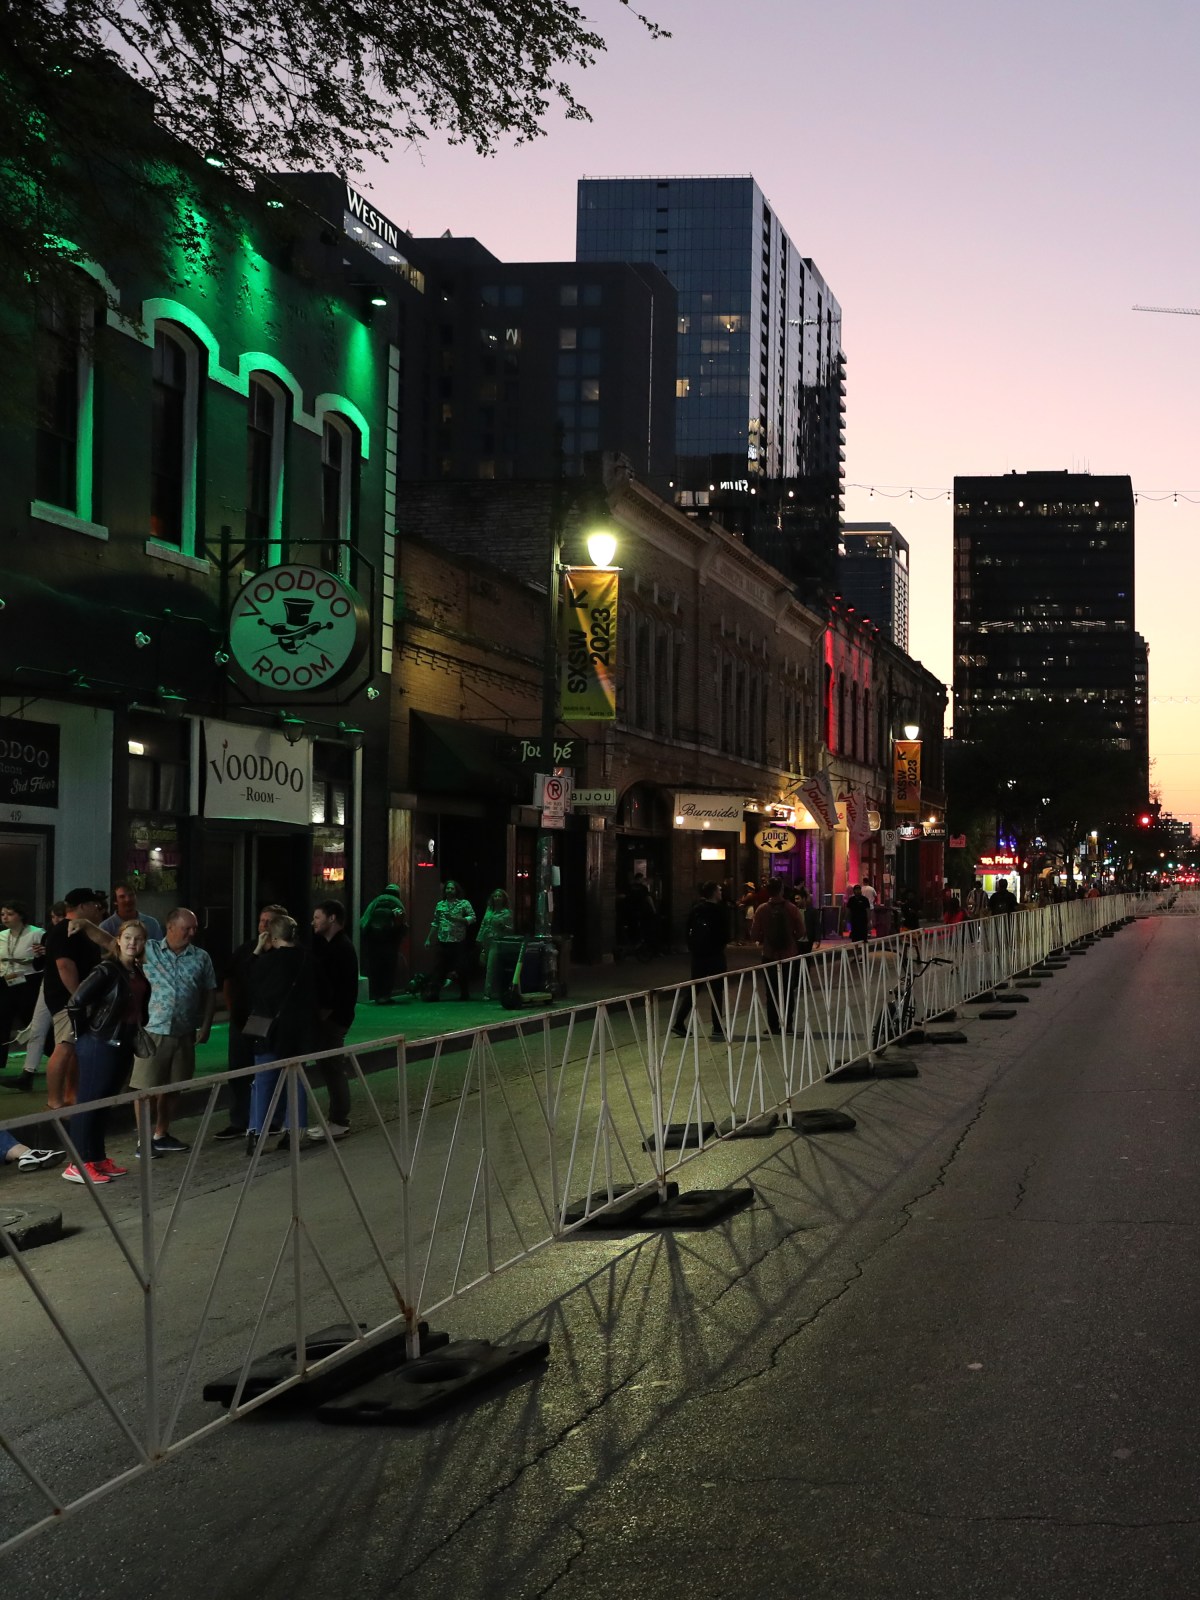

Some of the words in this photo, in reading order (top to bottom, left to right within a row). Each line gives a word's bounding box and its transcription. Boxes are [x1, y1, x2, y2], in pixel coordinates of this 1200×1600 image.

[346, 186, 398, 249] WESTIN
[239, 569, 351, 618] VOODOO
[589, 607, 611, 666] 2023
[252, 653, 334, 686] ROOM
[567, 629, 587, 694] SXSW
[209, 740, 304, 793] VOODOO
[521, 741, 574, 763] Touhé
[897, 770, 907, 800] SXSW
[907, 759, 917, 786] 2023
[572, 793, 611, 801] BIJOU
[682, 803, 738, 818] Burnside's
[761, 831, 788, 841] LODGE
